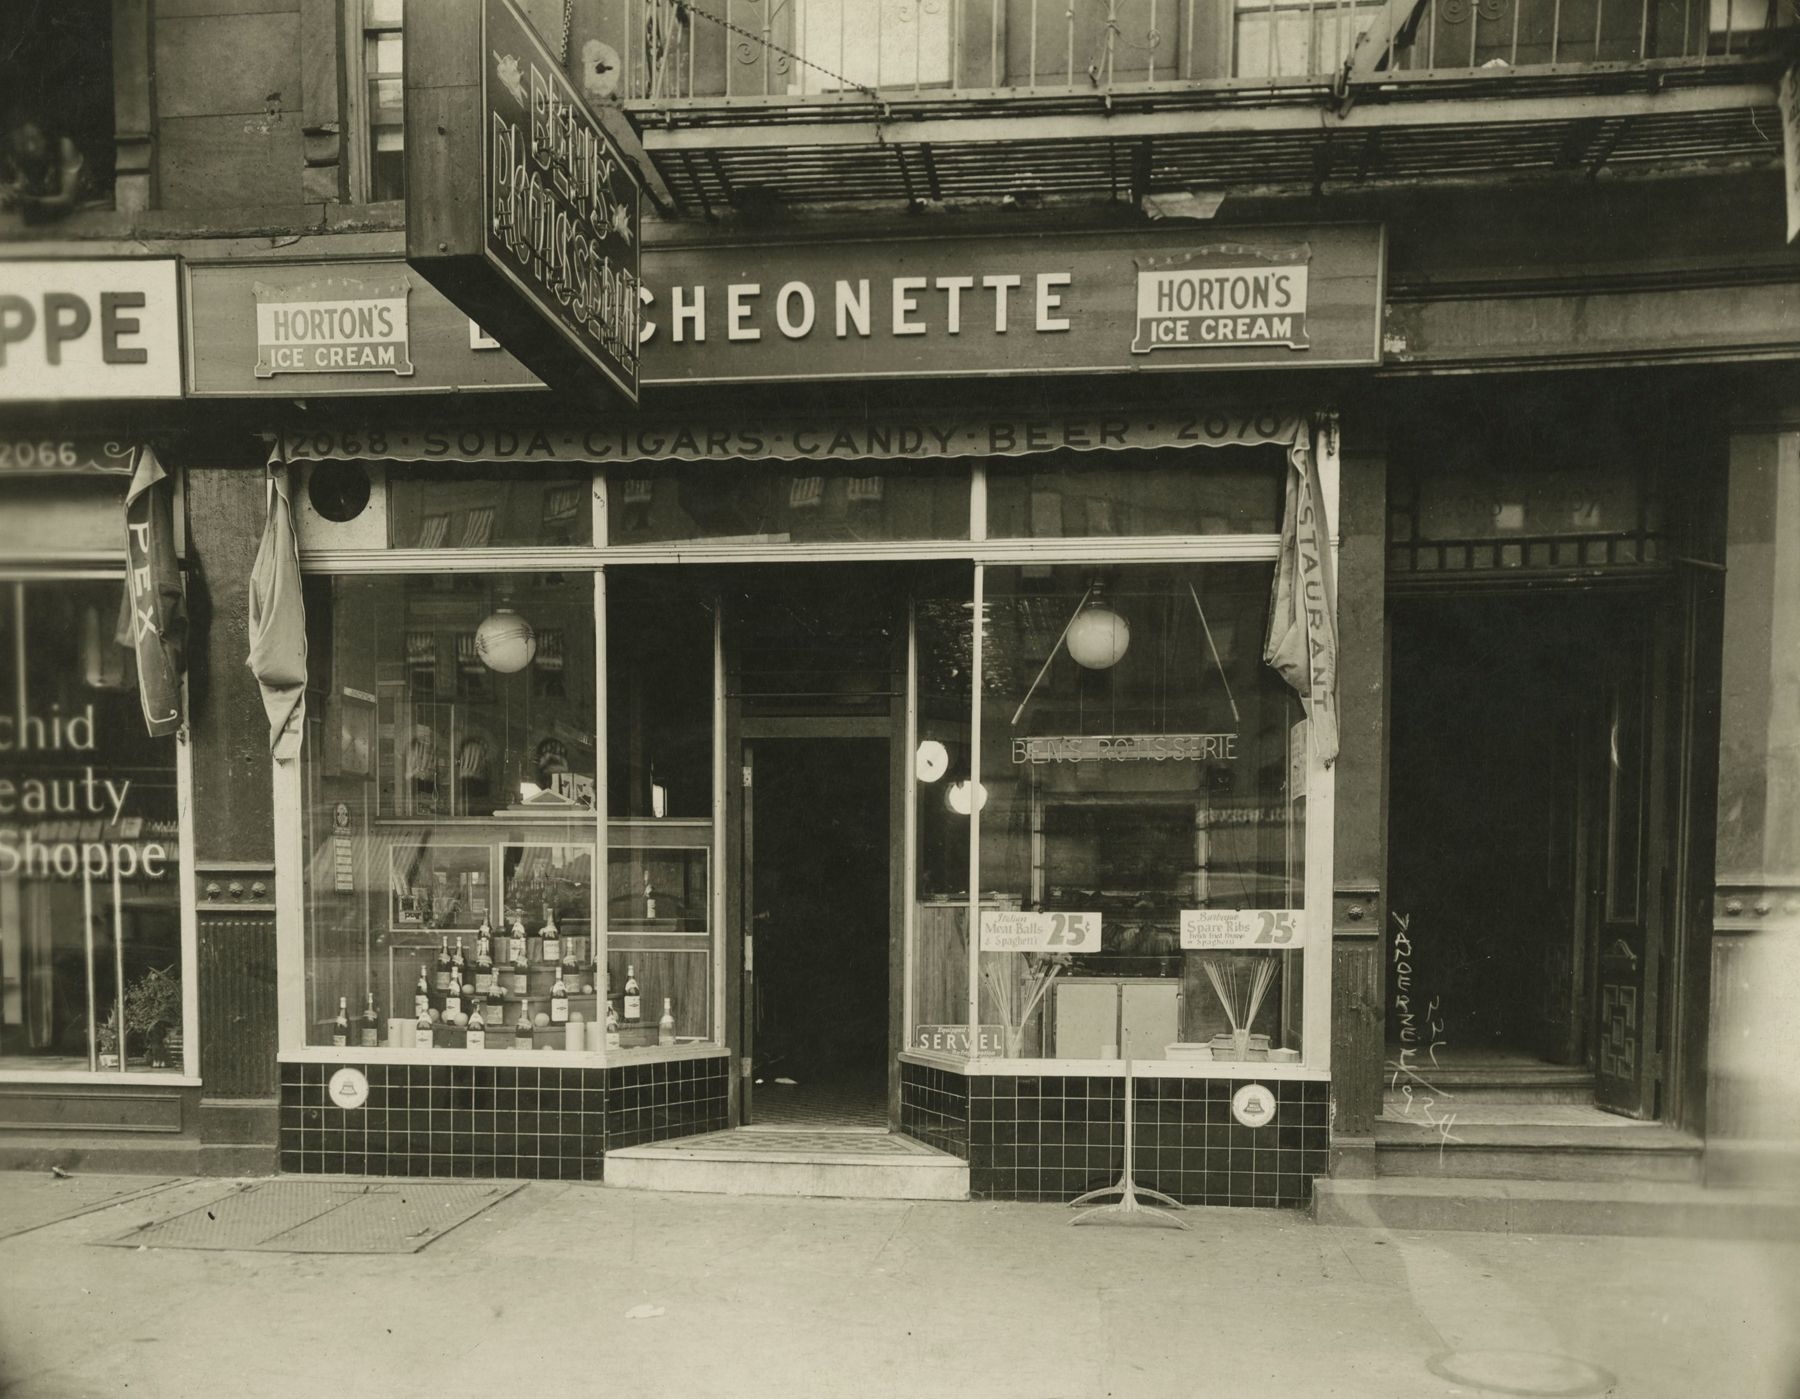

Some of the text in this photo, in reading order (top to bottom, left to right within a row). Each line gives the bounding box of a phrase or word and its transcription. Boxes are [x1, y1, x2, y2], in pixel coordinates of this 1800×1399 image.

[1157, 273, 1292, 312] HORTON'S
[273, 304, 394, 341] HORTON'S
[1151, 316, 1292, 342] ICE CREAM
[270, 346, 395, 368] ICE CREAM
[291, 404, 1282, 458] 2068 SODA CIGARS CANDY BEER 2070
[0, 828, 166, 892] Shoppe
[1016, 922, 1043, 934] Balls
[1187, 920, 1250, 934] Spare Ribs
[920, 1034, 1001, 1050] SERVEL
